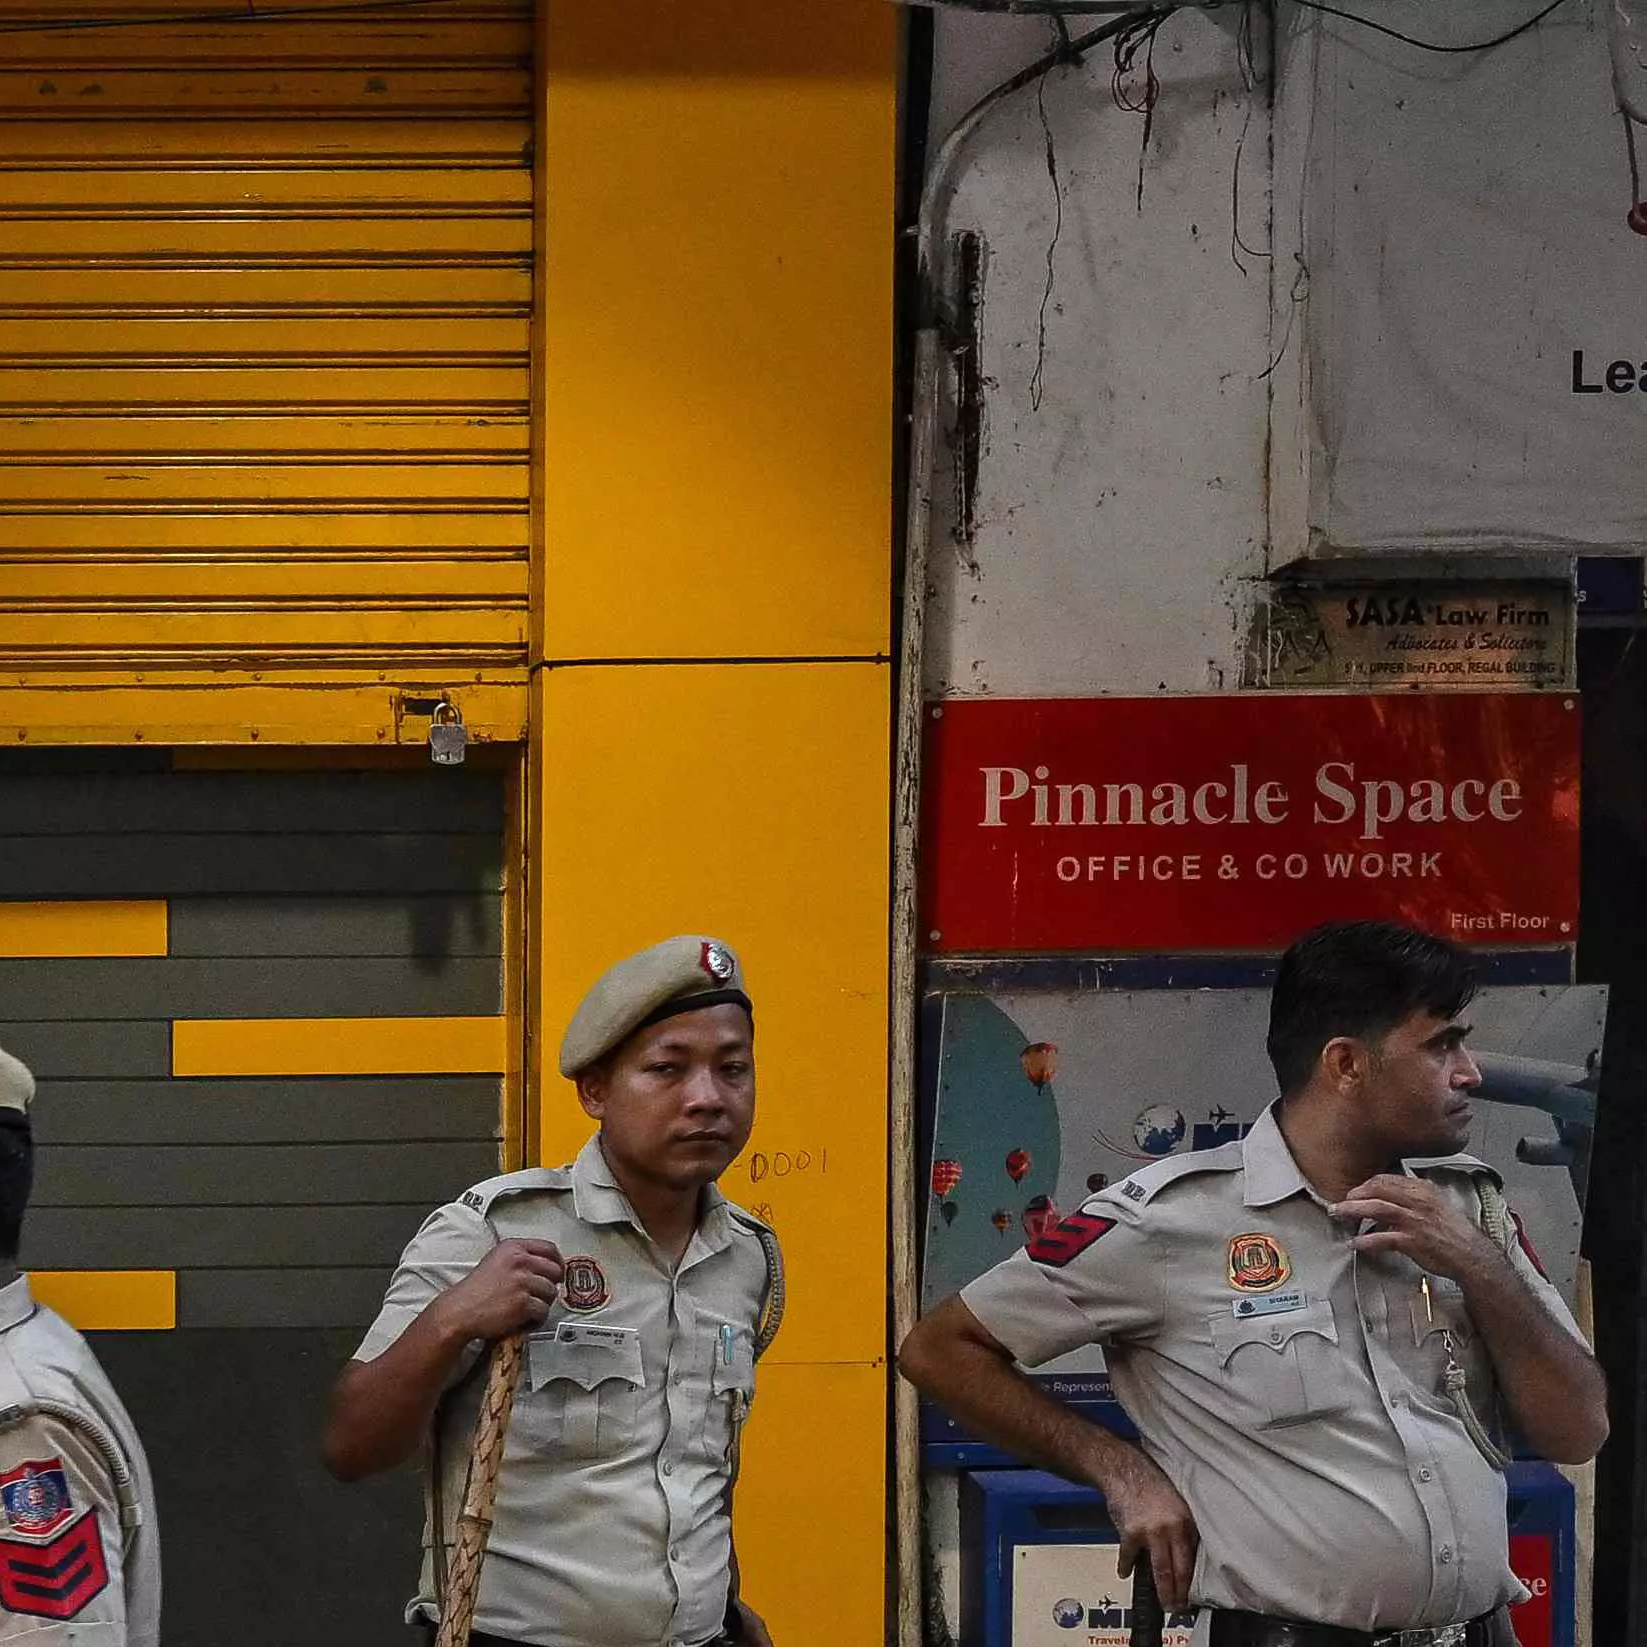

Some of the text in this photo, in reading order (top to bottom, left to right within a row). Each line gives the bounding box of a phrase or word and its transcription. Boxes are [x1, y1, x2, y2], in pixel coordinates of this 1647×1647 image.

[1346, 597, 1550, 628] SASA Law Firm
[1370, 662, 1404, 674] UPPER
[1427, 662, 1465, 675] FLOOR,
[1468, 662, 1503, 674] REGAL
[1506, 662, 1555, 674] BUILDING
[978, 761, 1523, 840] Pinnacle Space
[1057, 852, 1443, 882] OFFICE & CO WORK
[1451, 912, 1550, 930] First Floor
